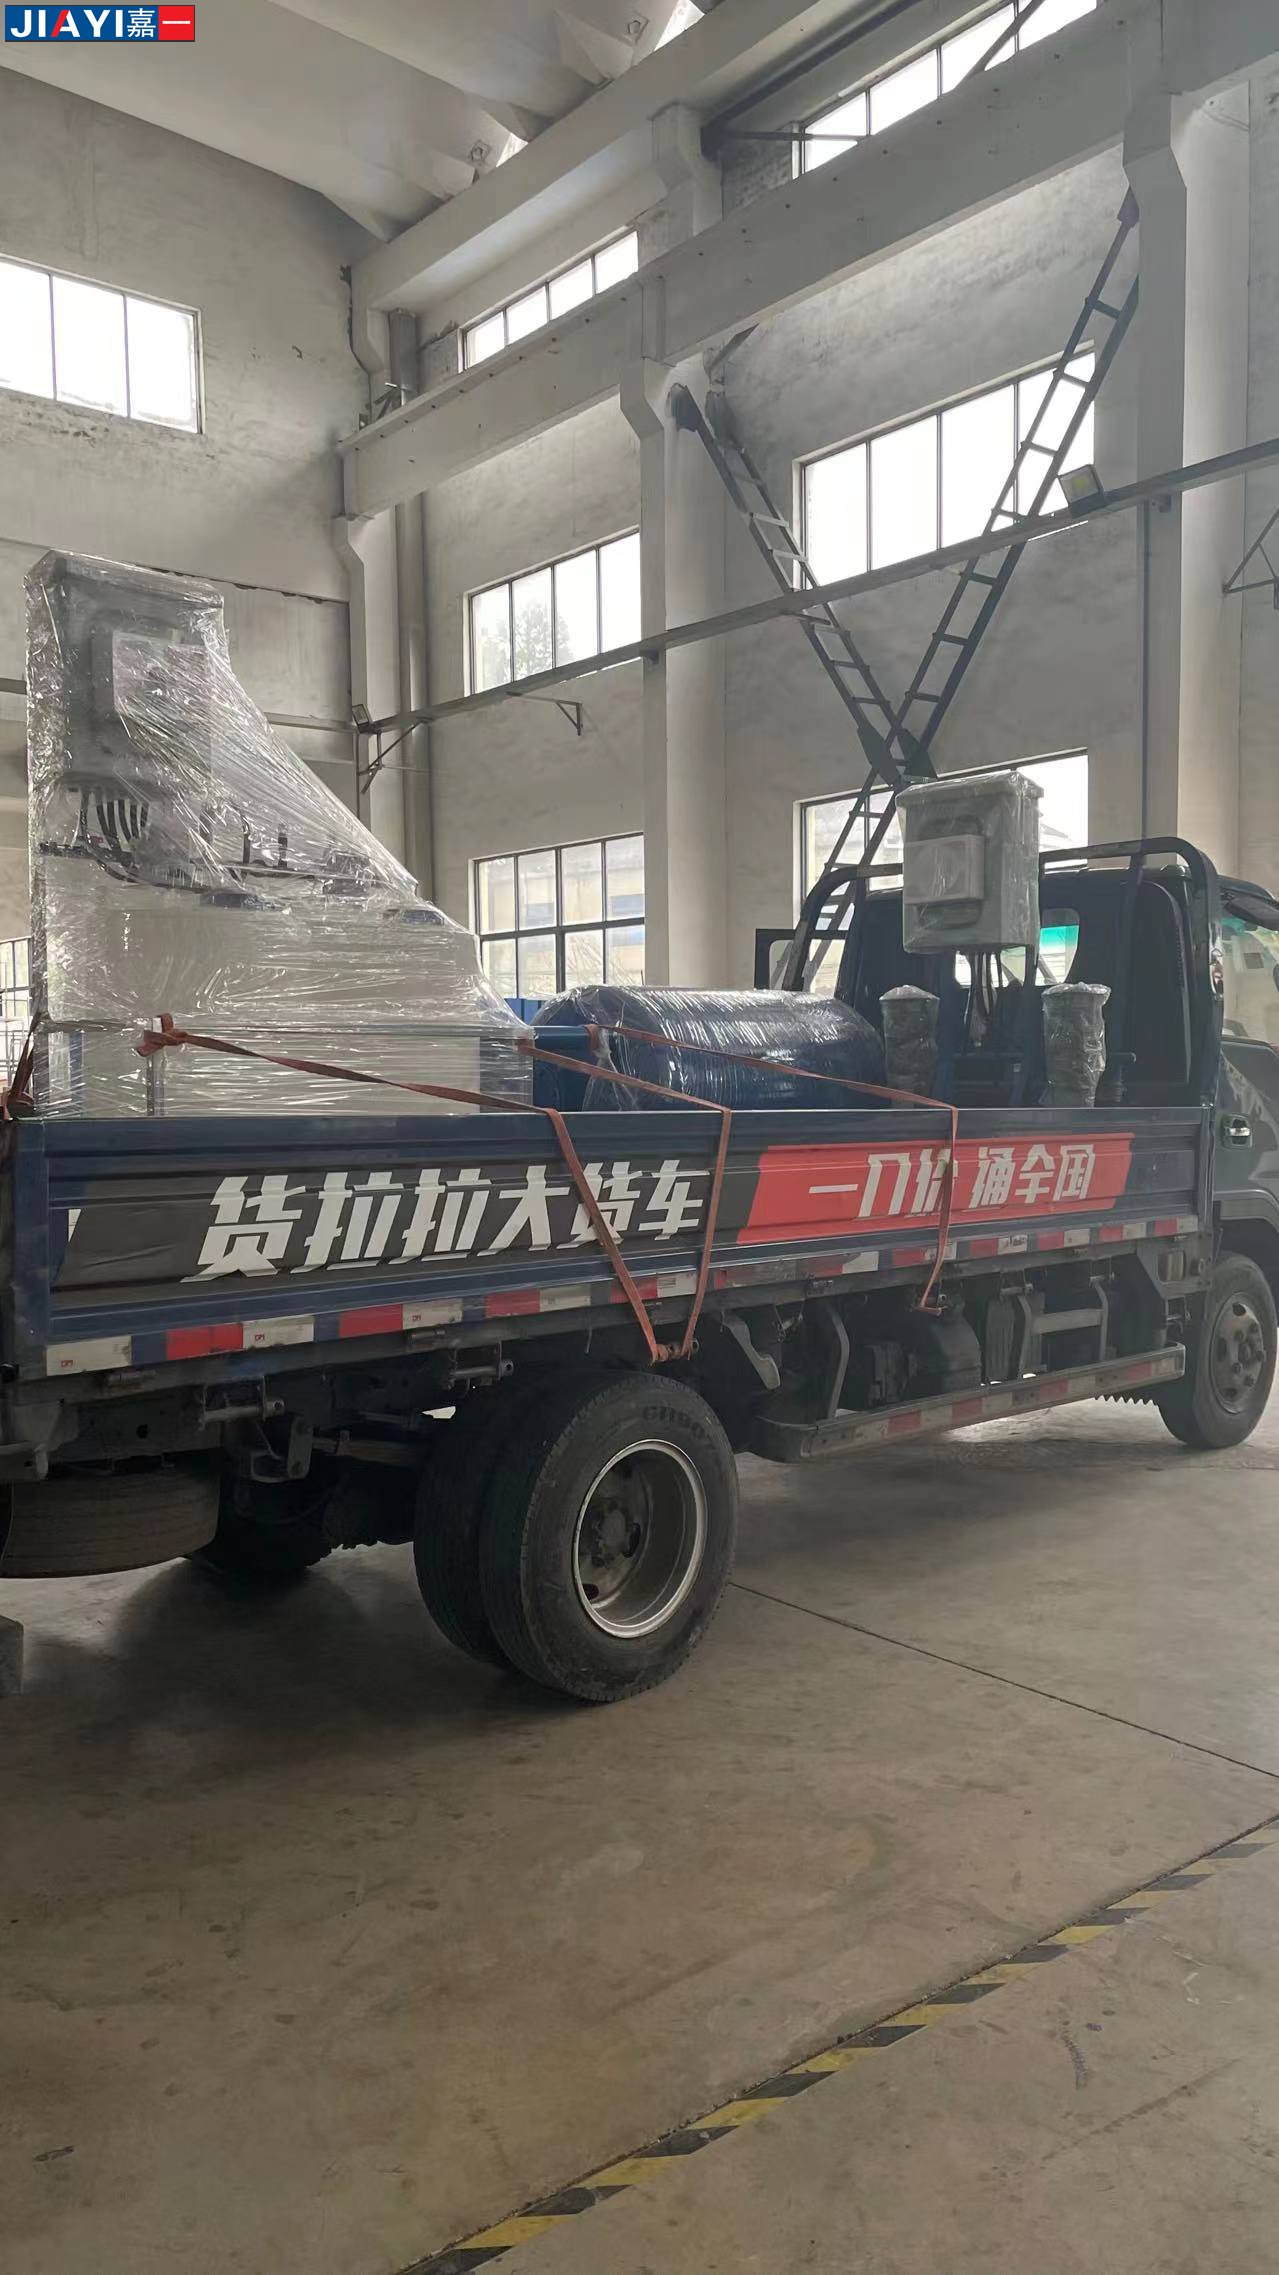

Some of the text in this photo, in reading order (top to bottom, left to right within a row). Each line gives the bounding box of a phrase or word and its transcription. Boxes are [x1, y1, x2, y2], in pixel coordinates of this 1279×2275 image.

[180, 1160, 711, 1283] 货拉拉大货车
